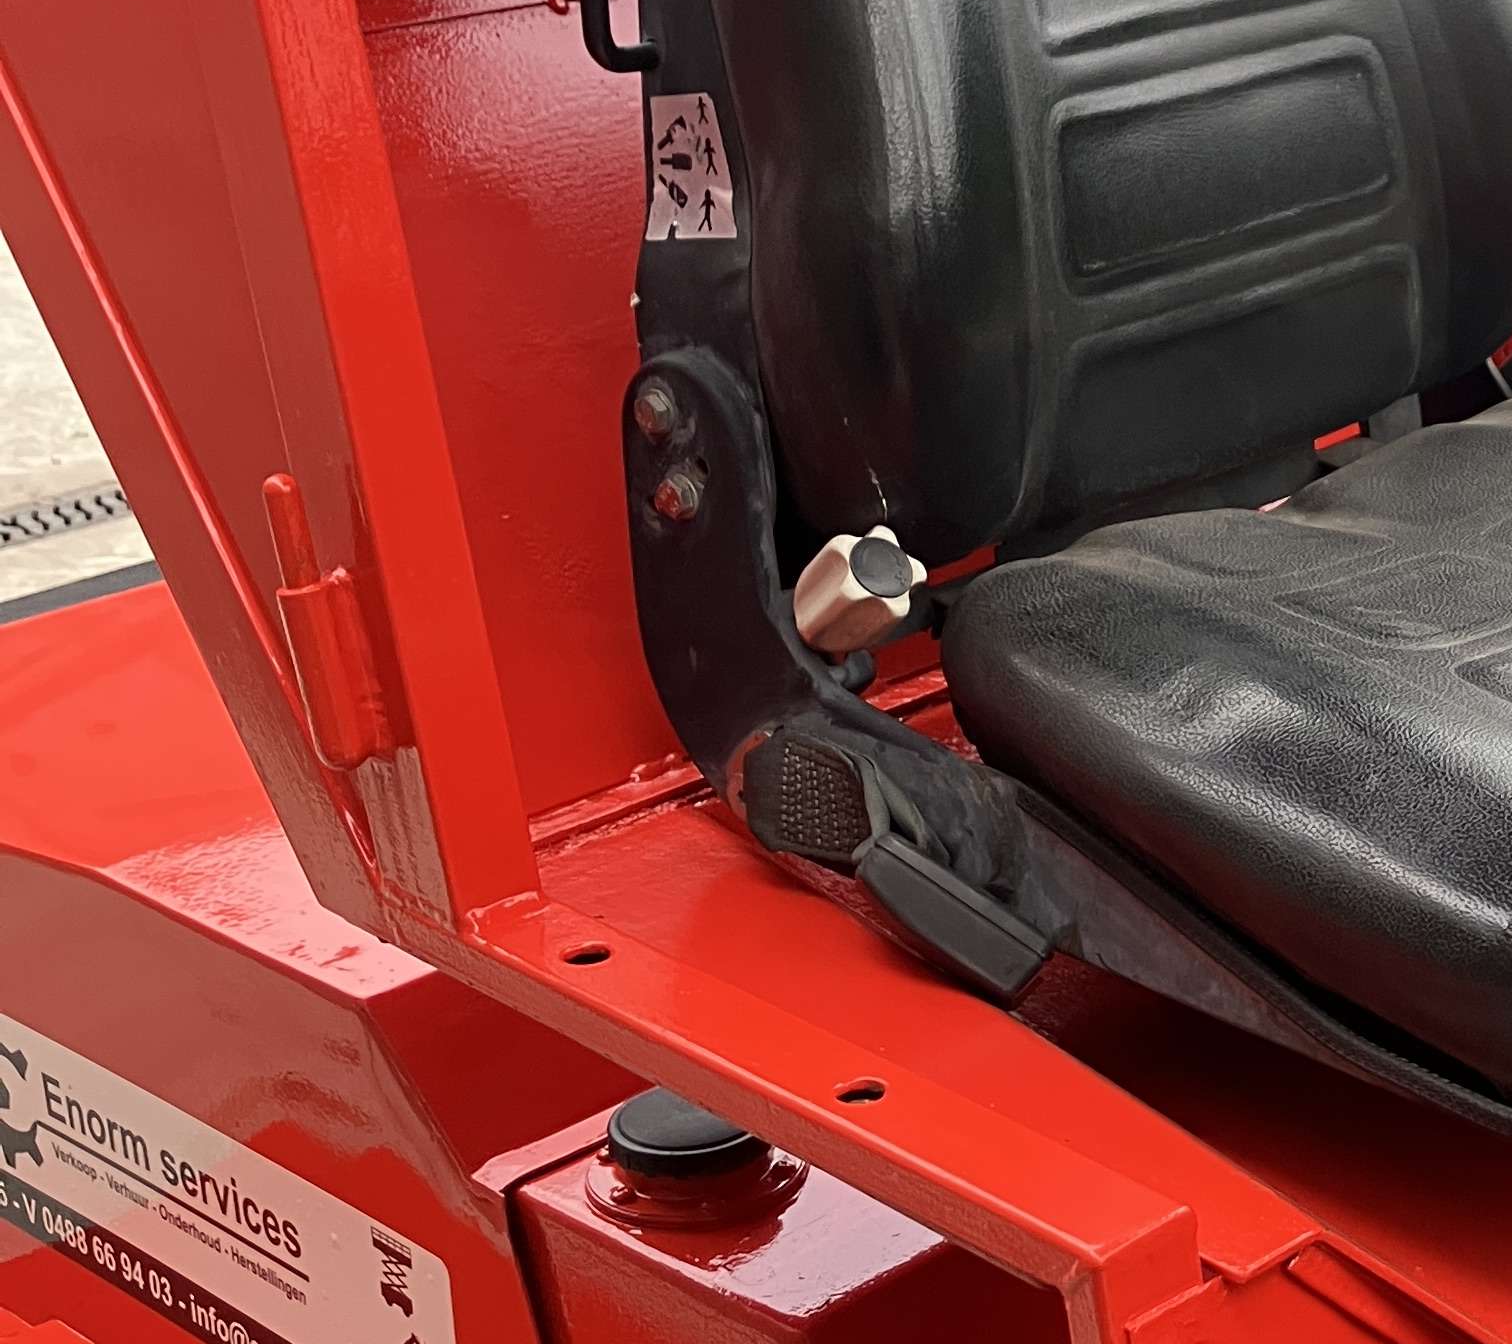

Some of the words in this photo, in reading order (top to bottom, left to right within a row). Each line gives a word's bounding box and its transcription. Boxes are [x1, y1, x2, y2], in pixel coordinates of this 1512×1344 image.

[41, 1071, 151, 1172] Enorm
[159, 1148, 302, 1259] services
[51, 1141, 97, 1183] Verkoop
[158, 1203, 222, 1254] Onderhoud
[21, 1191, 36, 1225] V
[42, 1205, 88, 1255] 0488
[92, 1234, 116, 1272] 66
[120, 1251, 145, 1291] 94
[149, 1269, 173, 1307] 03
